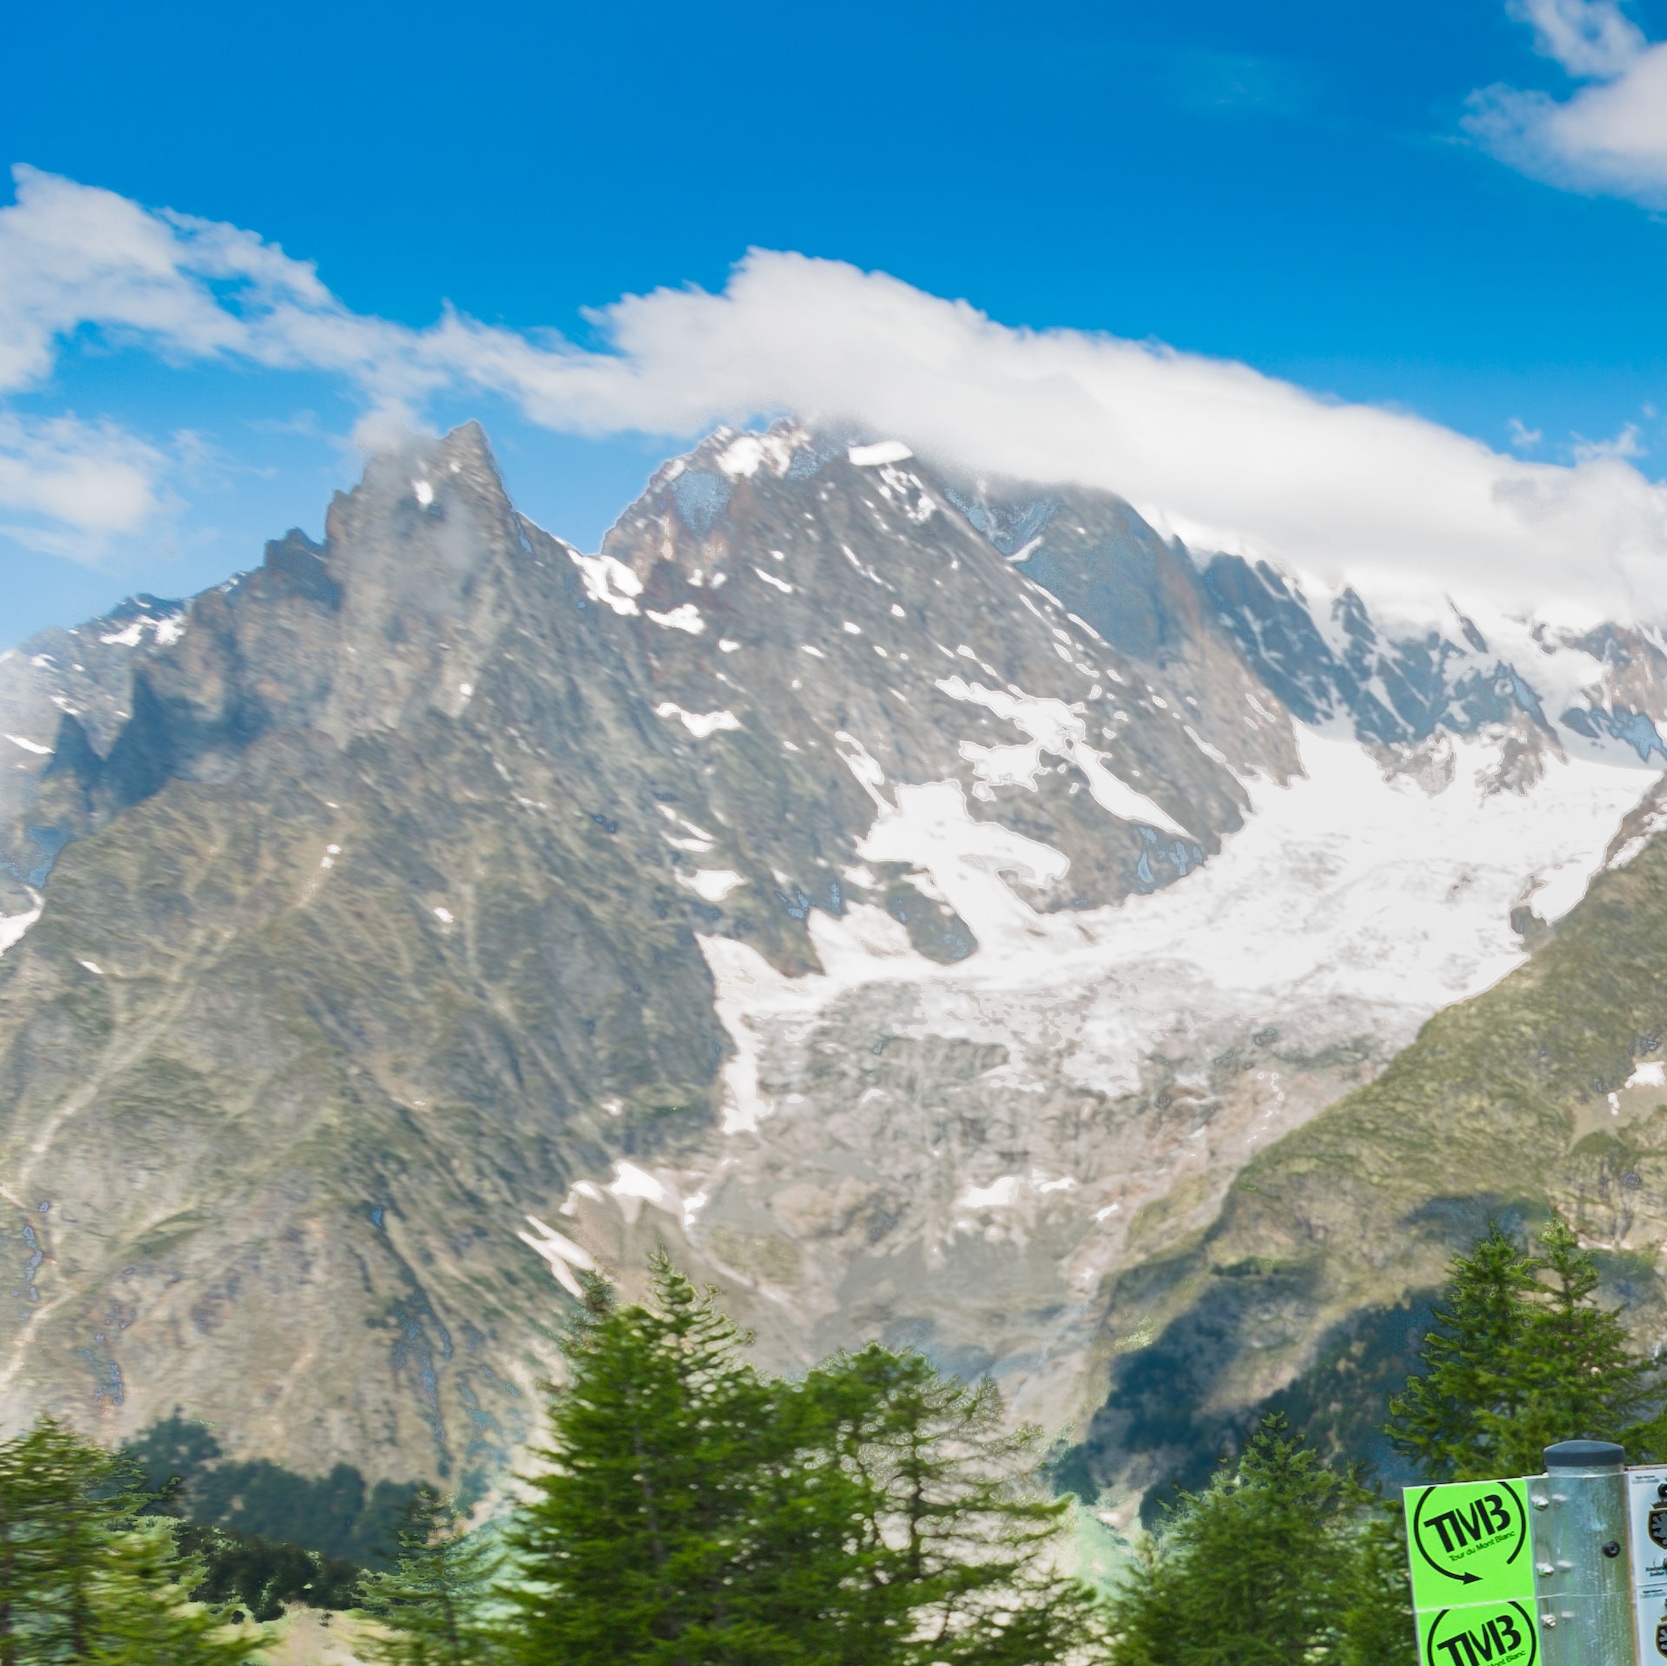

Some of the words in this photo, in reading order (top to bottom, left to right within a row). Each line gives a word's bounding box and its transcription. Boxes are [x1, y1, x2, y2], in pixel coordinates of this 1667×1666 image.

[1424, 1494, 1511, 1553] TMB
[1448, 1552, 1465, 1563] Tour
[1466, 1547, 1476, 1557] du
[1476, 1536, 1495, 1553] Mont
[1495, 1530, 1516, 1544] Blanc
